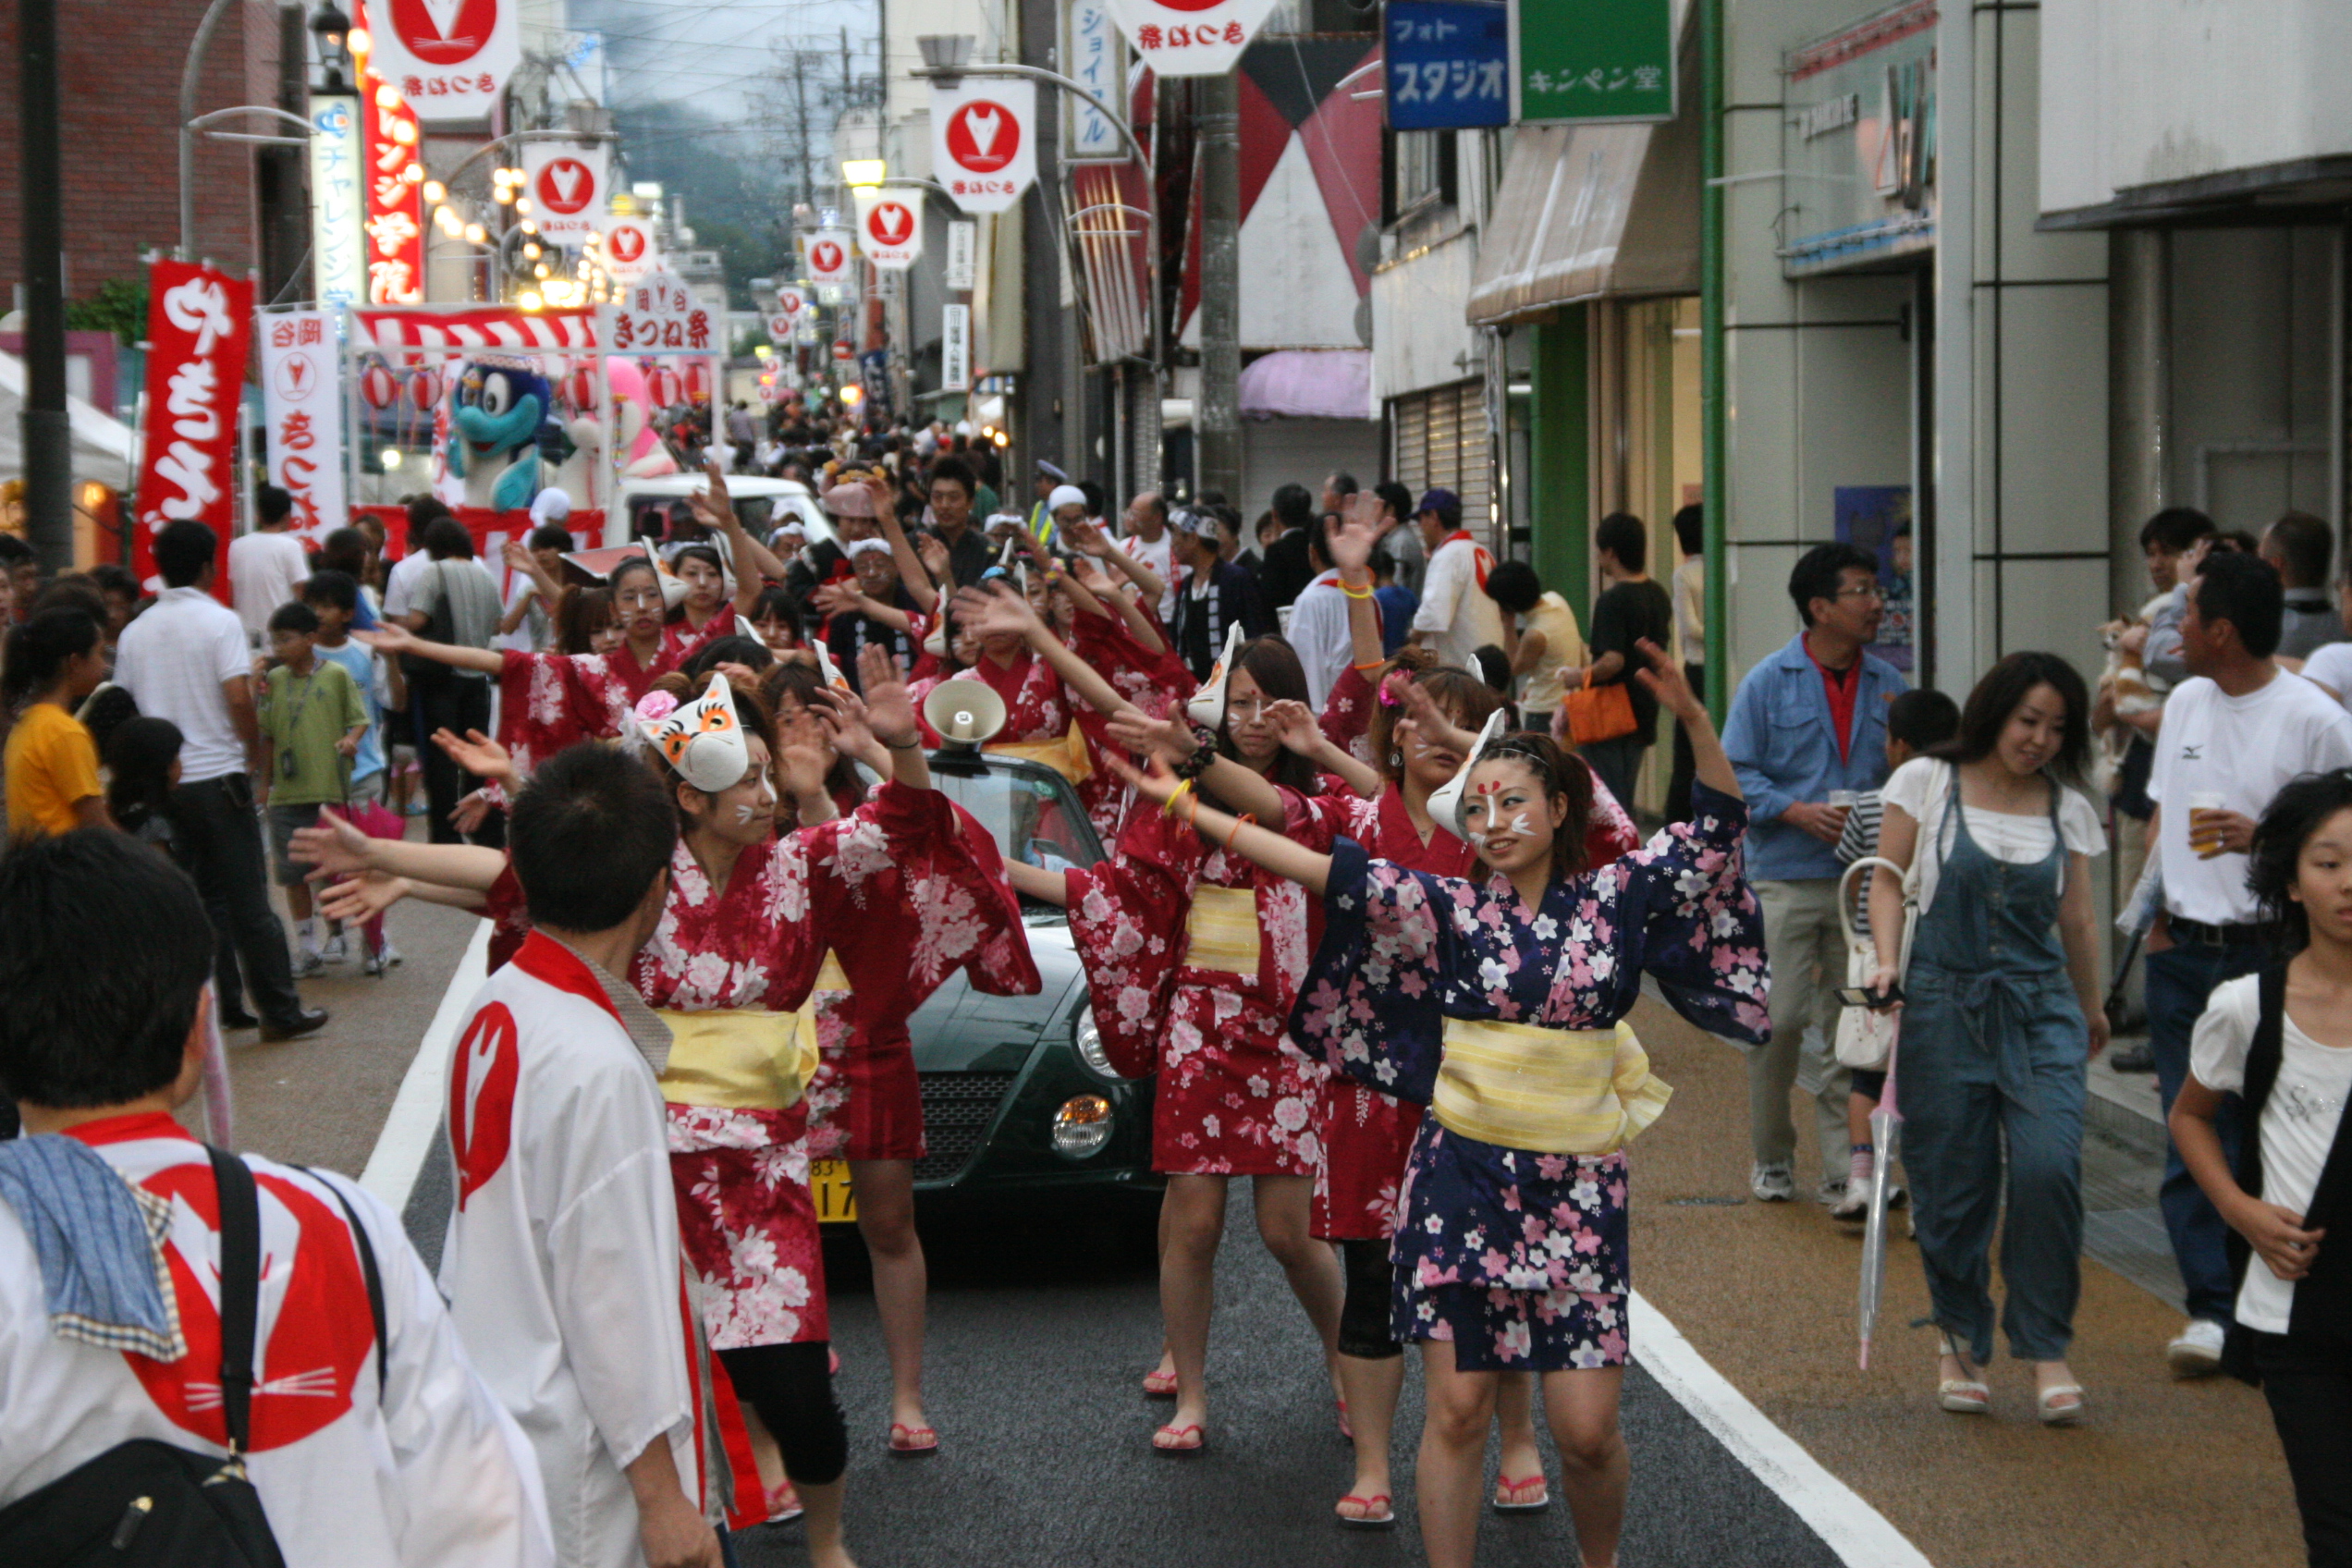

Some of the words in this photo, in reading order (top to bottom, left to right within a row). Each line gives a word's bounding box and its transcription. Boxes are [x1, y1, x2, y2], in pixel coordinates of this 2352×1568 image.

[1393, 18, 1458, 43] フォト
[1394, 58, 1506, 104] スタジオ
[1528, 65, 1663, 93] キンペン堂
[614, 310, 709, 349] きつね祭
